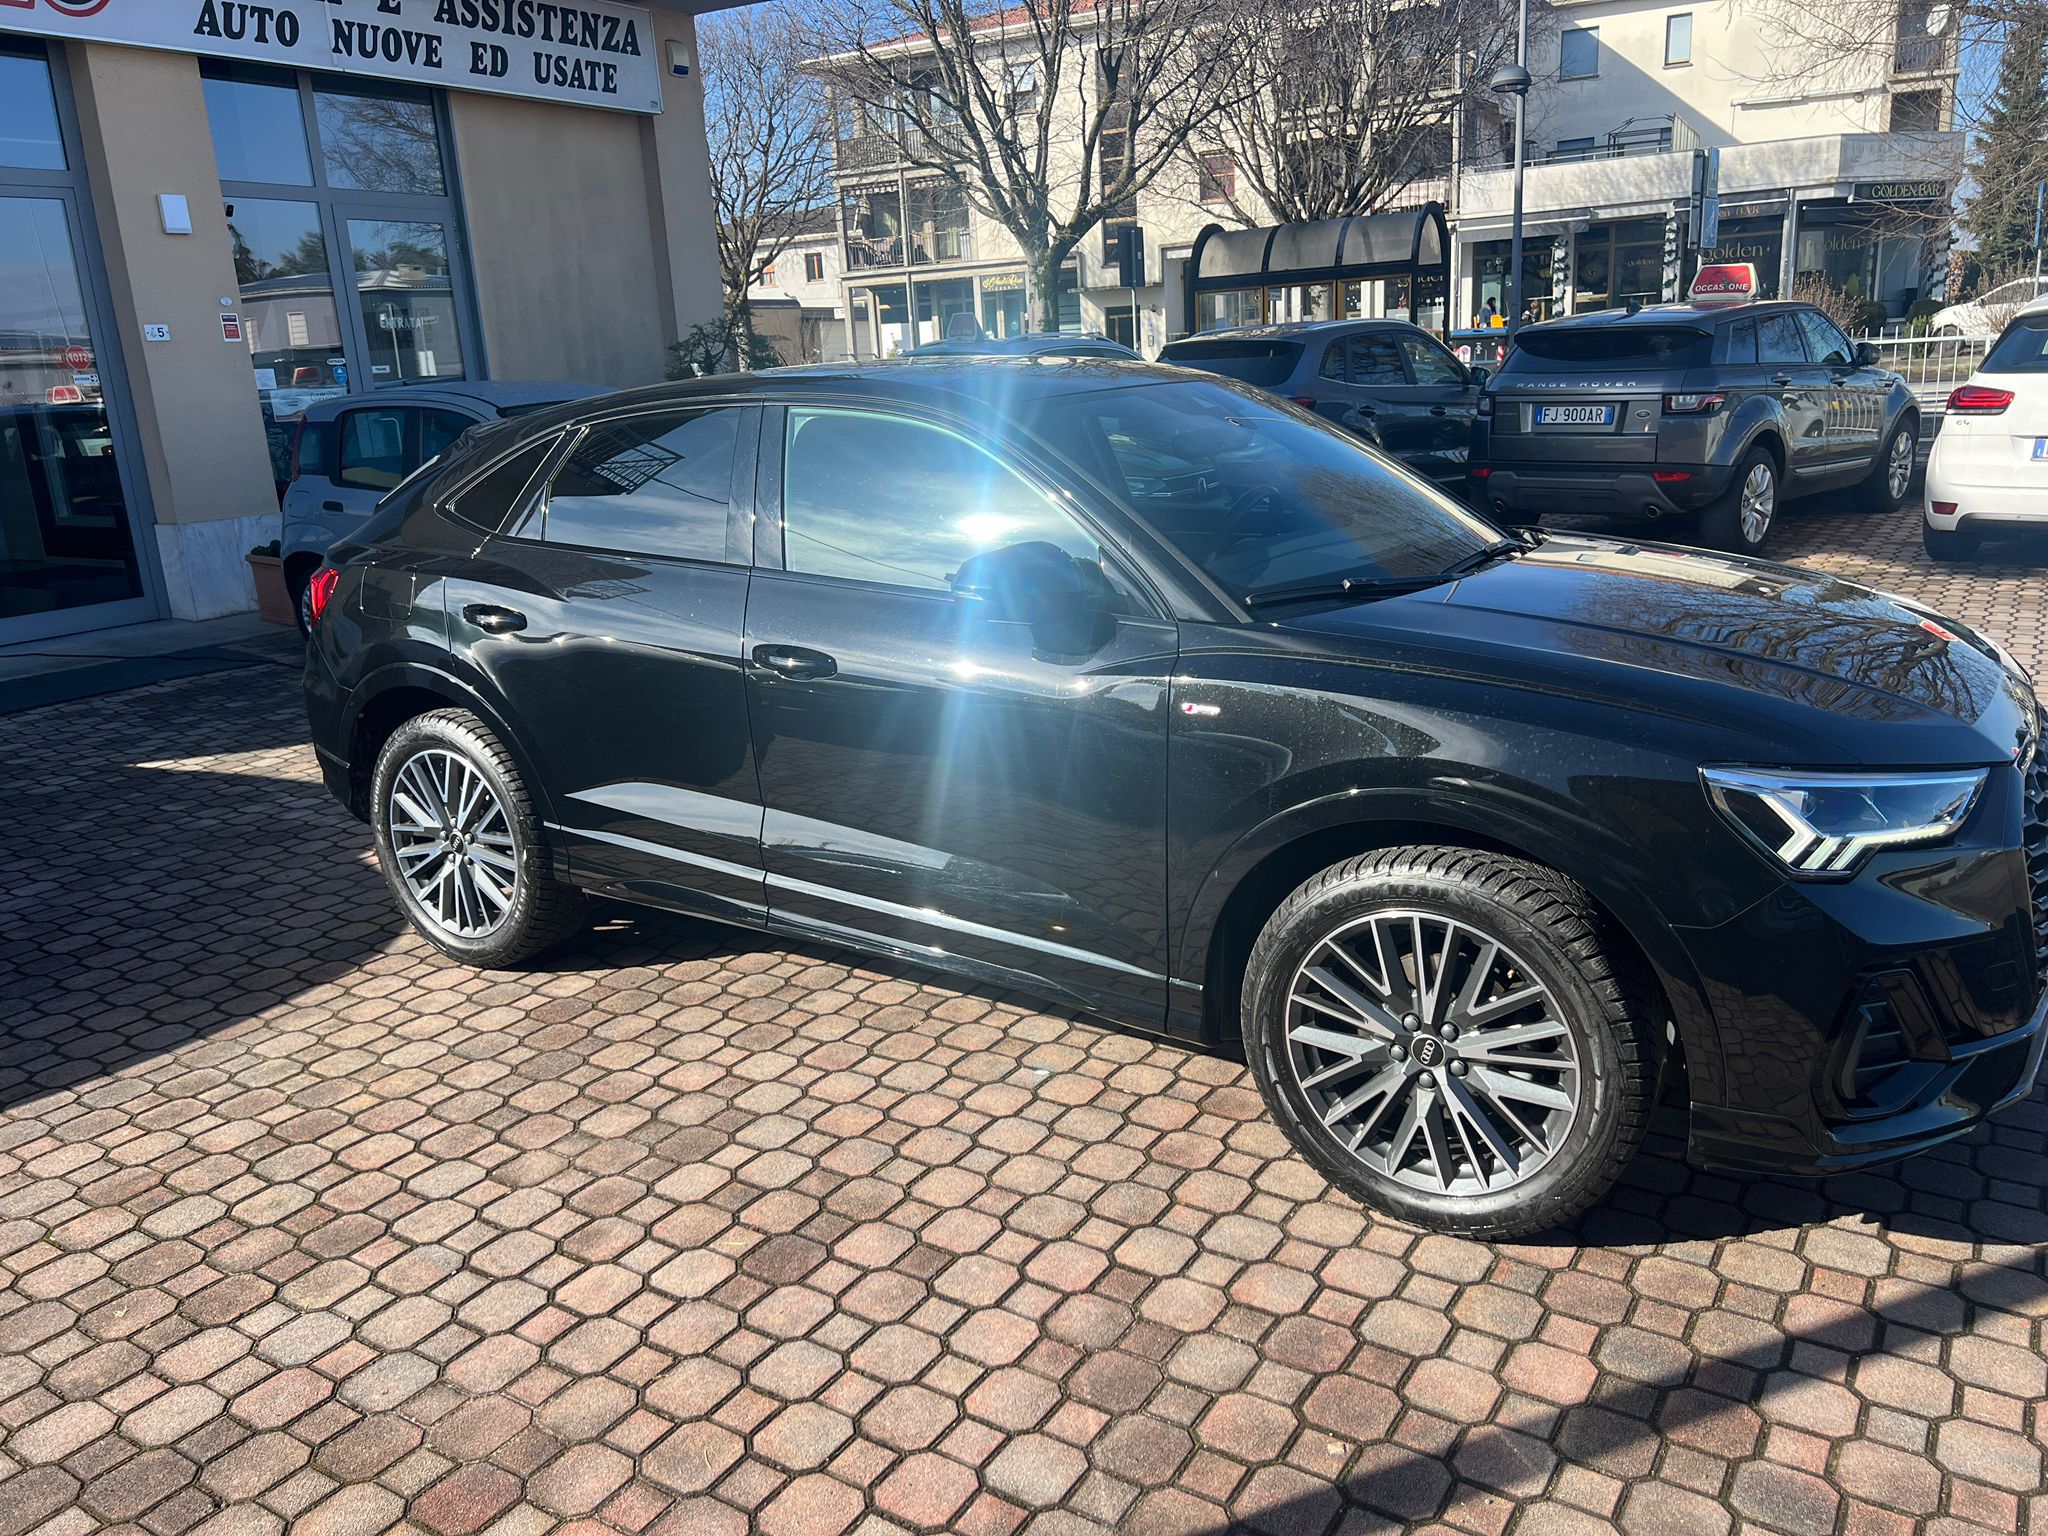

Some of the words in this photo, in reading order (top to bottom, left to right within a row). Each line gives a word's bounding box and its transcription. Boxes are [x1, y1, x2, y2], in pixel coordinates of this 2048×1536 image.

[433, 0, 642, 57] ASSISTENZA
[193, 0, 300, 48] AUTO
[331, 18, 443, 69] NUOVE
[469, 41, 509, 78] ED
[533, 51, 618, 94] USATE
[1871, 184, 1917, 198] GOLDEN
[1919, 183, 1941, 197] BAR
[1736, 204, 1760, 216] BAR
[1701, 242, 1763, 264] golden
[1695, 283, 1749, 292] OCCASONE
[157, 328, 165, 338] 5
[1543, 408, 1559, 422] FJ
[1563, 408, 1603, 422] 900AR
